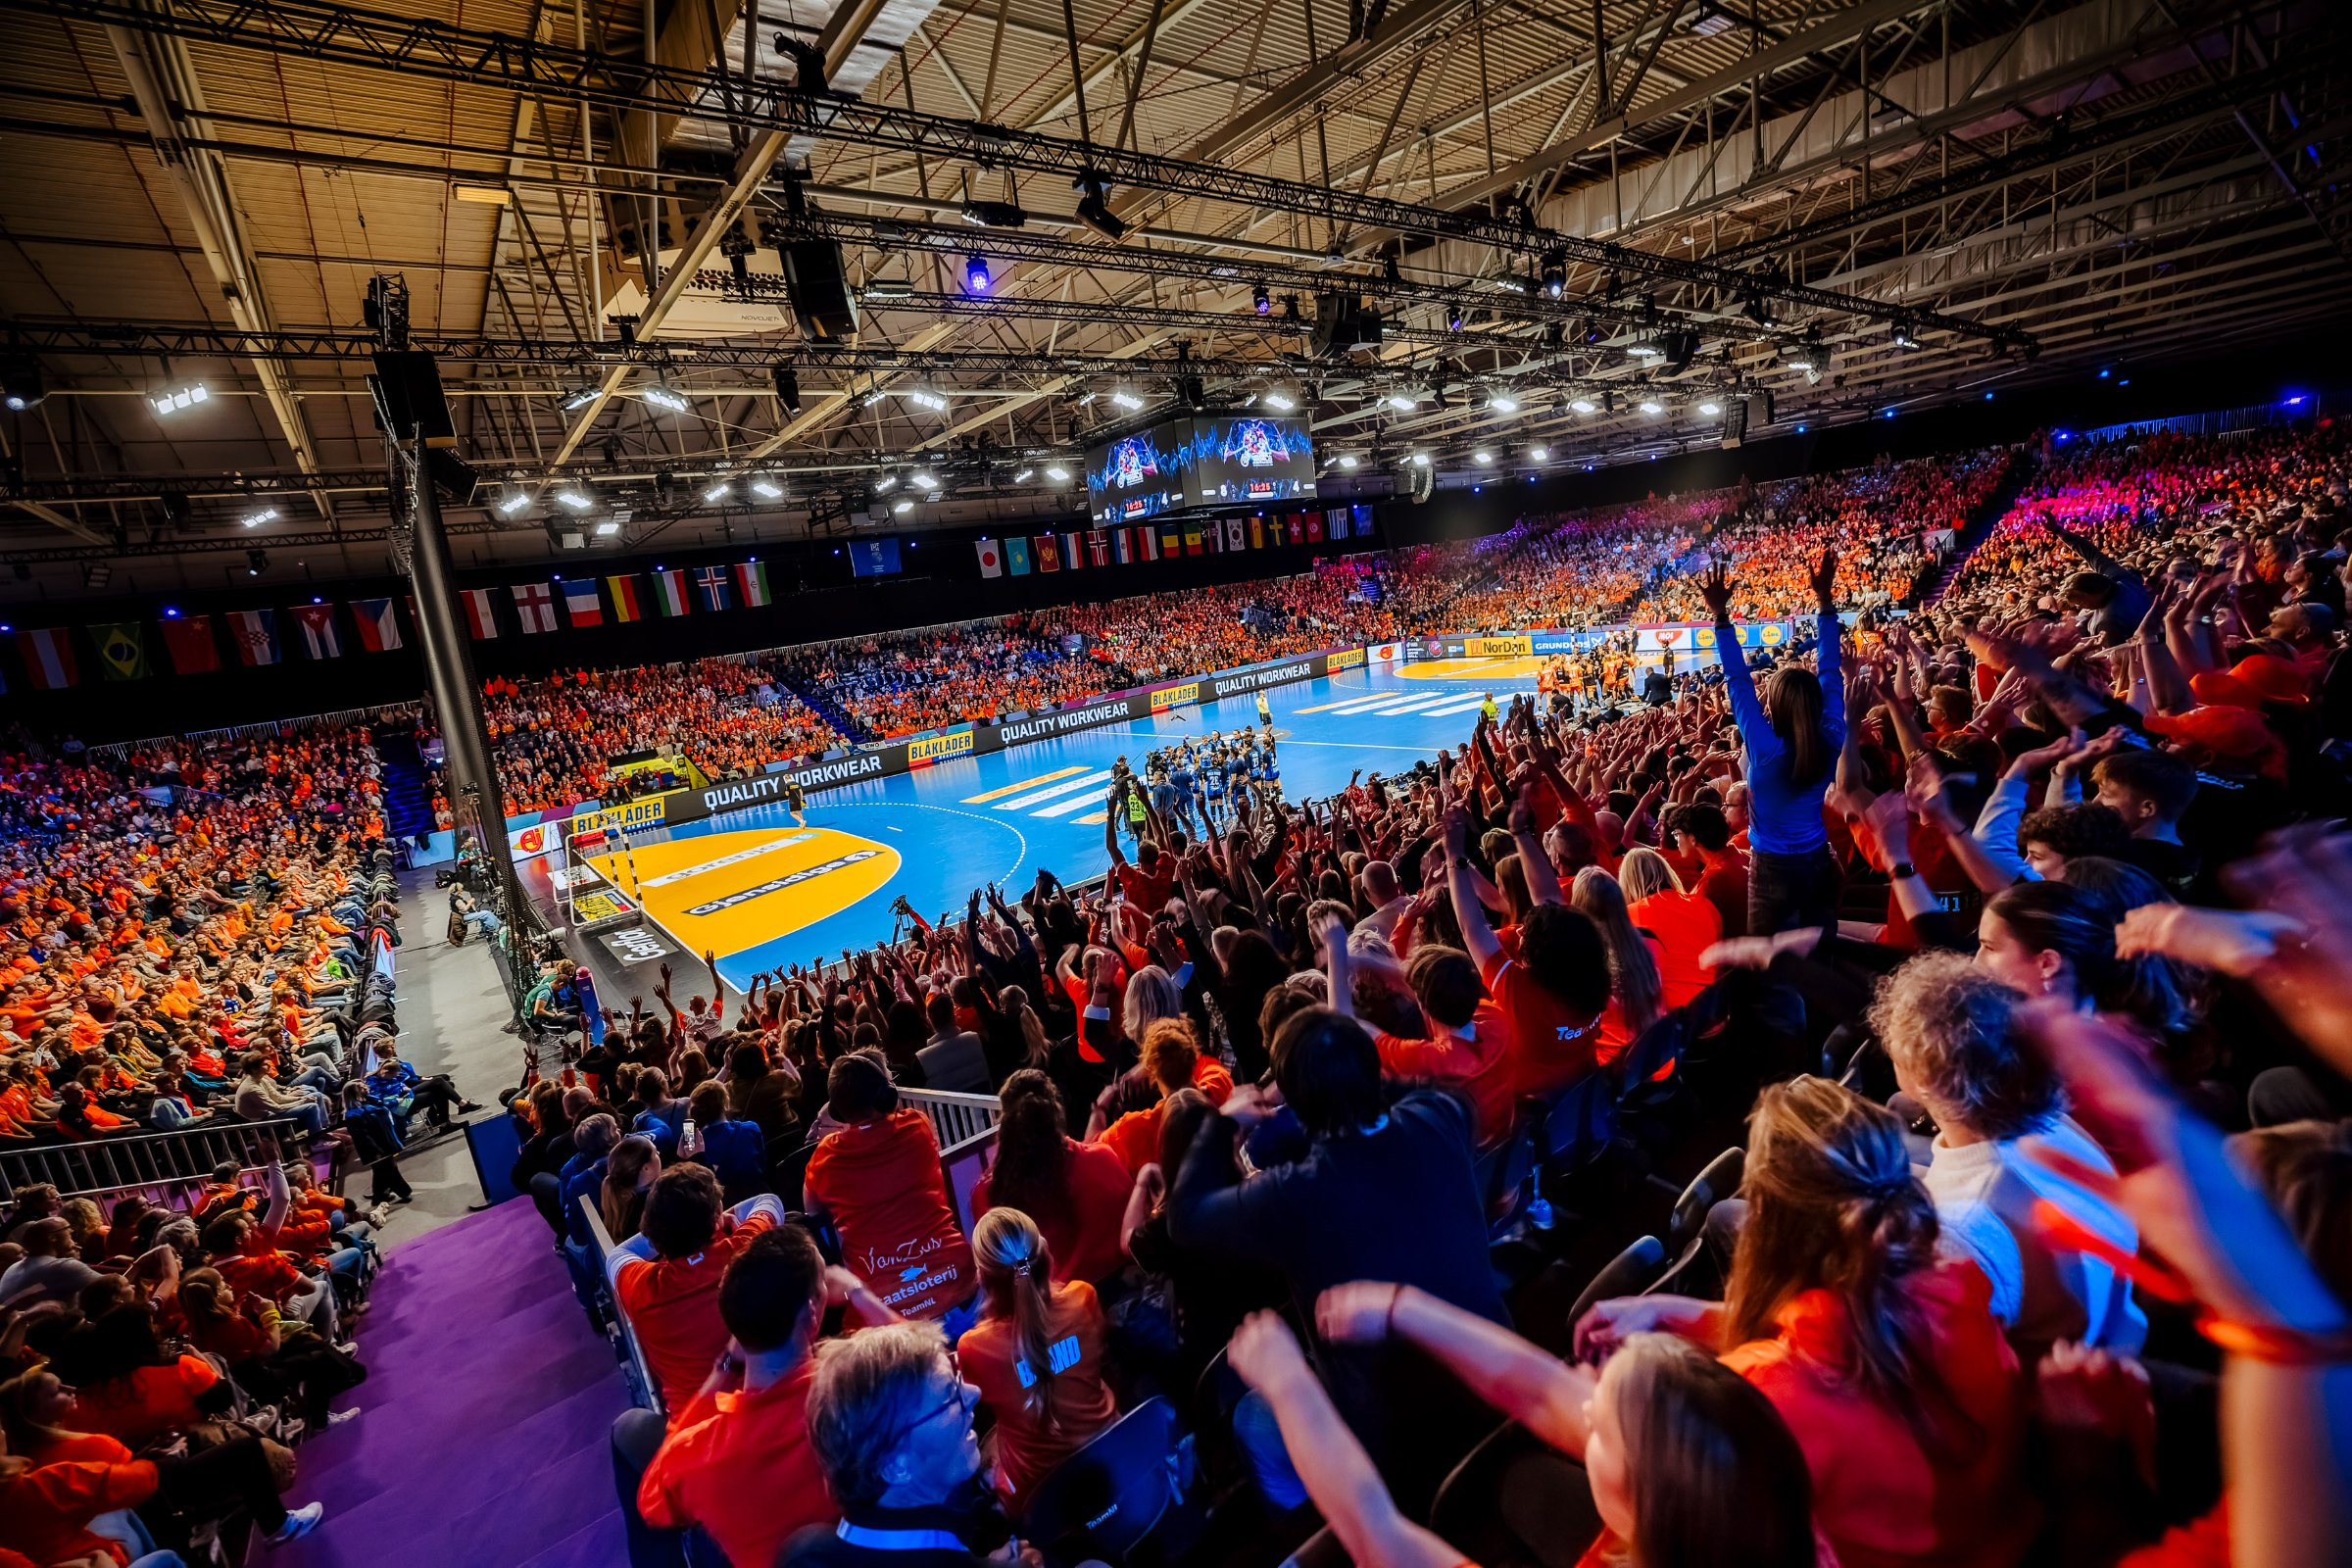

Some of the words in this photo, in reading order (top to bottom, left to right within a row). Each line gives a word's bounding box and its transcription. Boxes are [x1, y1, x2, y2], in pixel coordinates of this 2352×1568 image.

[1250, 482, 1271, 492] 16:25
[1125, 500, 1143, 512] 16:25
[1535, 640, 1591, 651] GRUNDOS
[1215, 673, 1259, 697] QUALITY
[1256, 662, 1311, 686] WORKWEAR
[1001, 716, 1055, 744] QUALITY
[1056, 702, 1129, 728] WORKWEAR
[911, 734, 971, 760] BLÅKLÄDER
[704, 777, 780, 810] QUALITY
[1130, 801, 1141, 812] 33
[689, 859, 847, 915] Gjensidige
[900, 1297, 937, 1317] TeamNL
